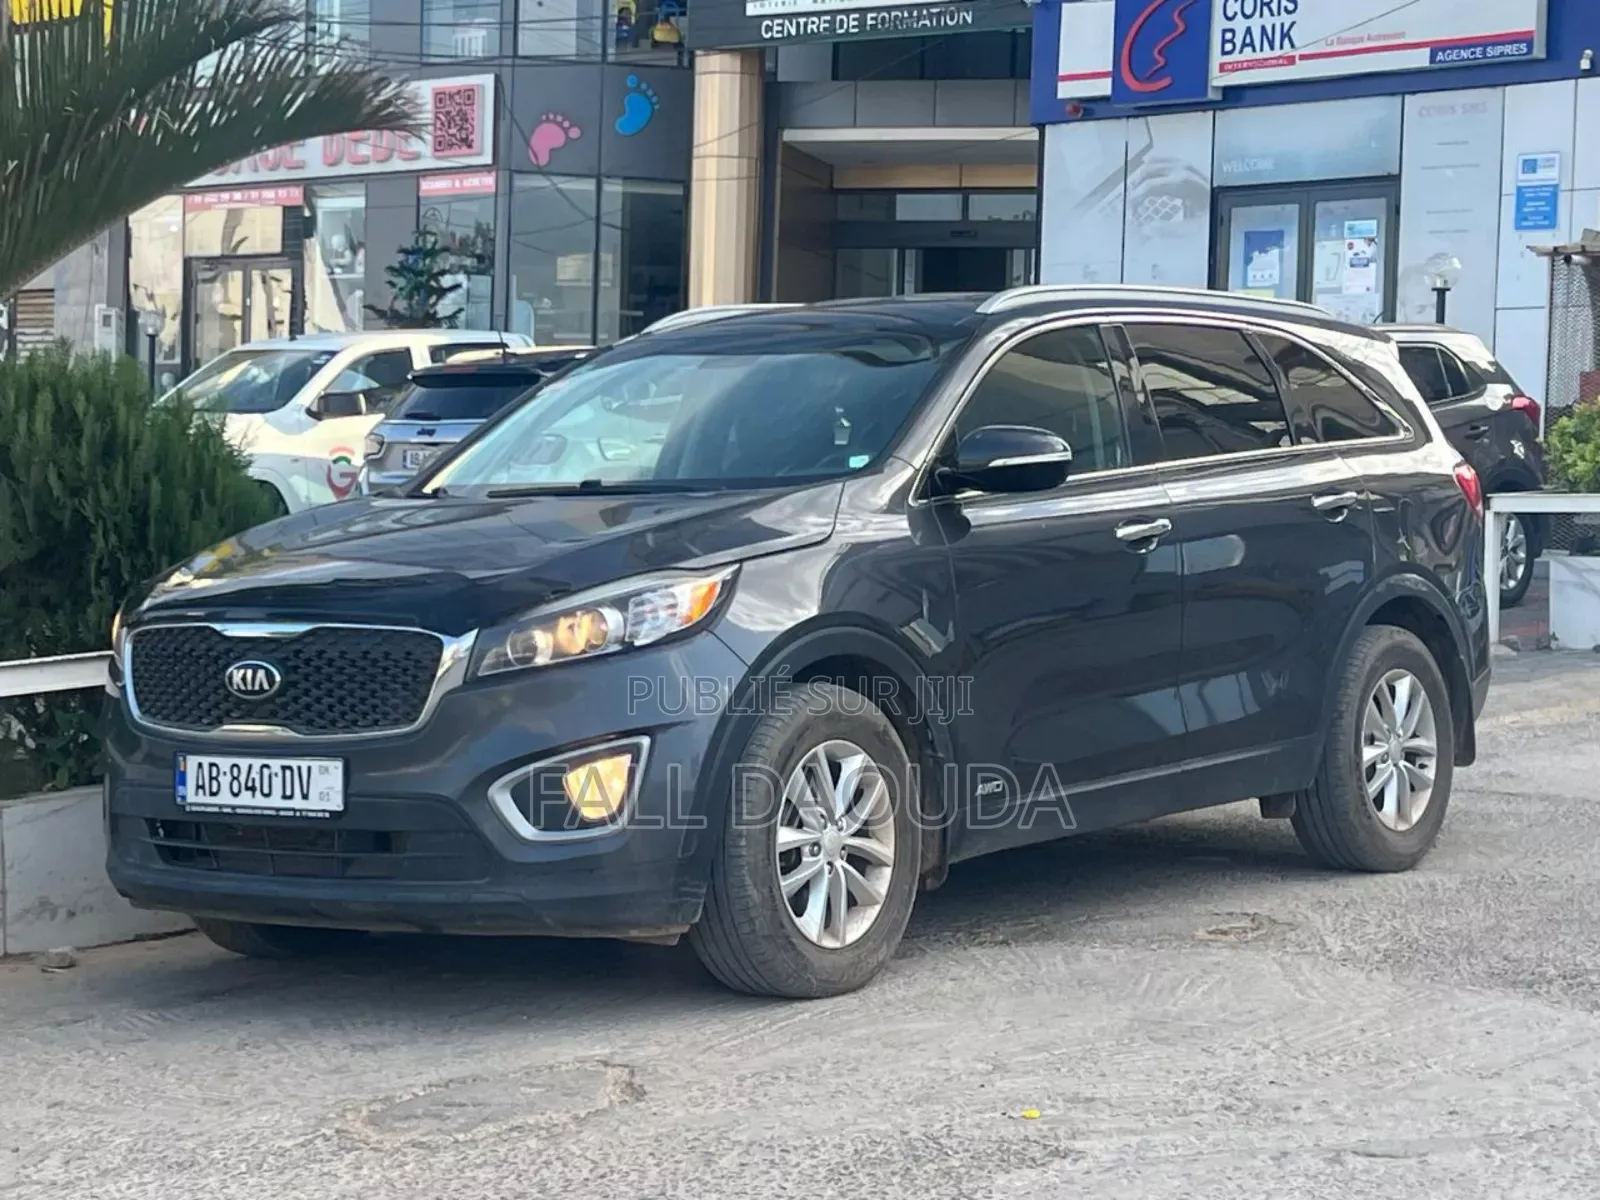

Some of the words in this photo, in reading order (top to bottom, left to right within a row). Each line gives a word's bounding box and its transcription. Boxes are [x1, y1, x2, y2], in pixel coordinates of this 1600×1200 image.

[761, 16, 831, 39] CENTRE
[836, 13, 860, 34] DE
[866, 6, 974, 31] FORMATION
[1223, 0, 1299, 22] CORIS
[1220, 20, 1297, 56] BANK
[1436, 46, 1484, 62] AGENCE
[1486, 43, 1528, 57] SIPRES
[232, 668, 270, 691] KIA
